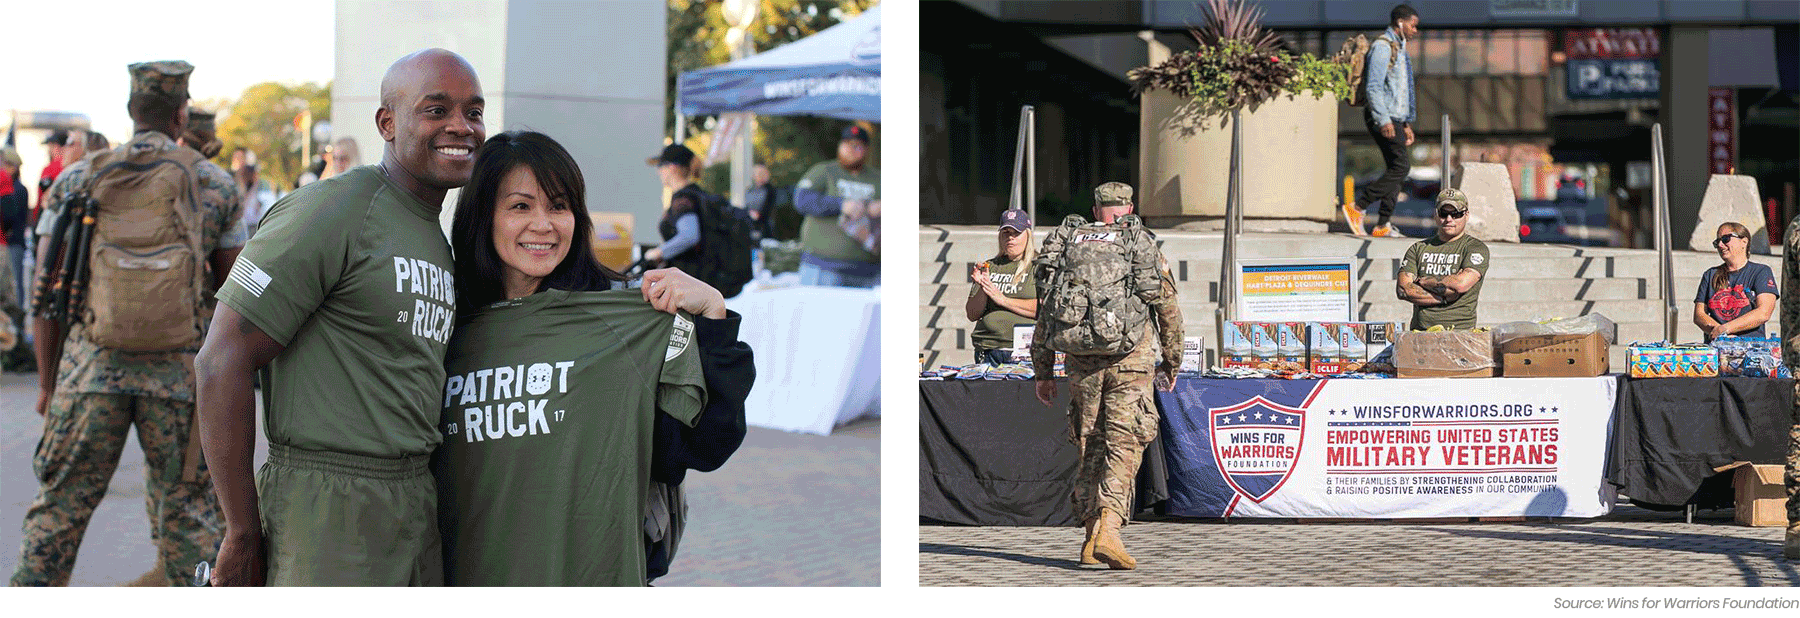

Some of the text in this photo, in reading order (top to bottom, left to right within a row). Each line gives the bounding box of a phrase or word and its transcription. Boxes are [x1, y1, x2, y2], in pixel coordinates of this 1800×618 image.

[1422, 252, 1461, 265] PATRIOT
[1426, 263, 1452, 276] RUCK
[397, 298, 454, 345] 20 RUCK
[444, 360, 575, 409] PATRIOT
[1353, 404, 1533, 419] WINSFORWARRIORS.ORG
[447, 398, 566, 443] 20 RUCK 17
[1230, 432, 1285, 444] WINS FOR
[1327, 427, 1559, 445] EMPOWERING UNITED STATES
[1221, 444, 1295, 459] WARRIORS
[1326, 444, 1558, 467] MILITARY VETERANS
[1227, 460, 1288, 468] FOUNDATION
[1327, 475, 1558, 486] & THEIR FAMILIES BY STRENGTHENING COLLABORATION
[1327, 485, 1557, 495] & RAISING POSITIVE AWARENESS IN OUR COMMUNITY
